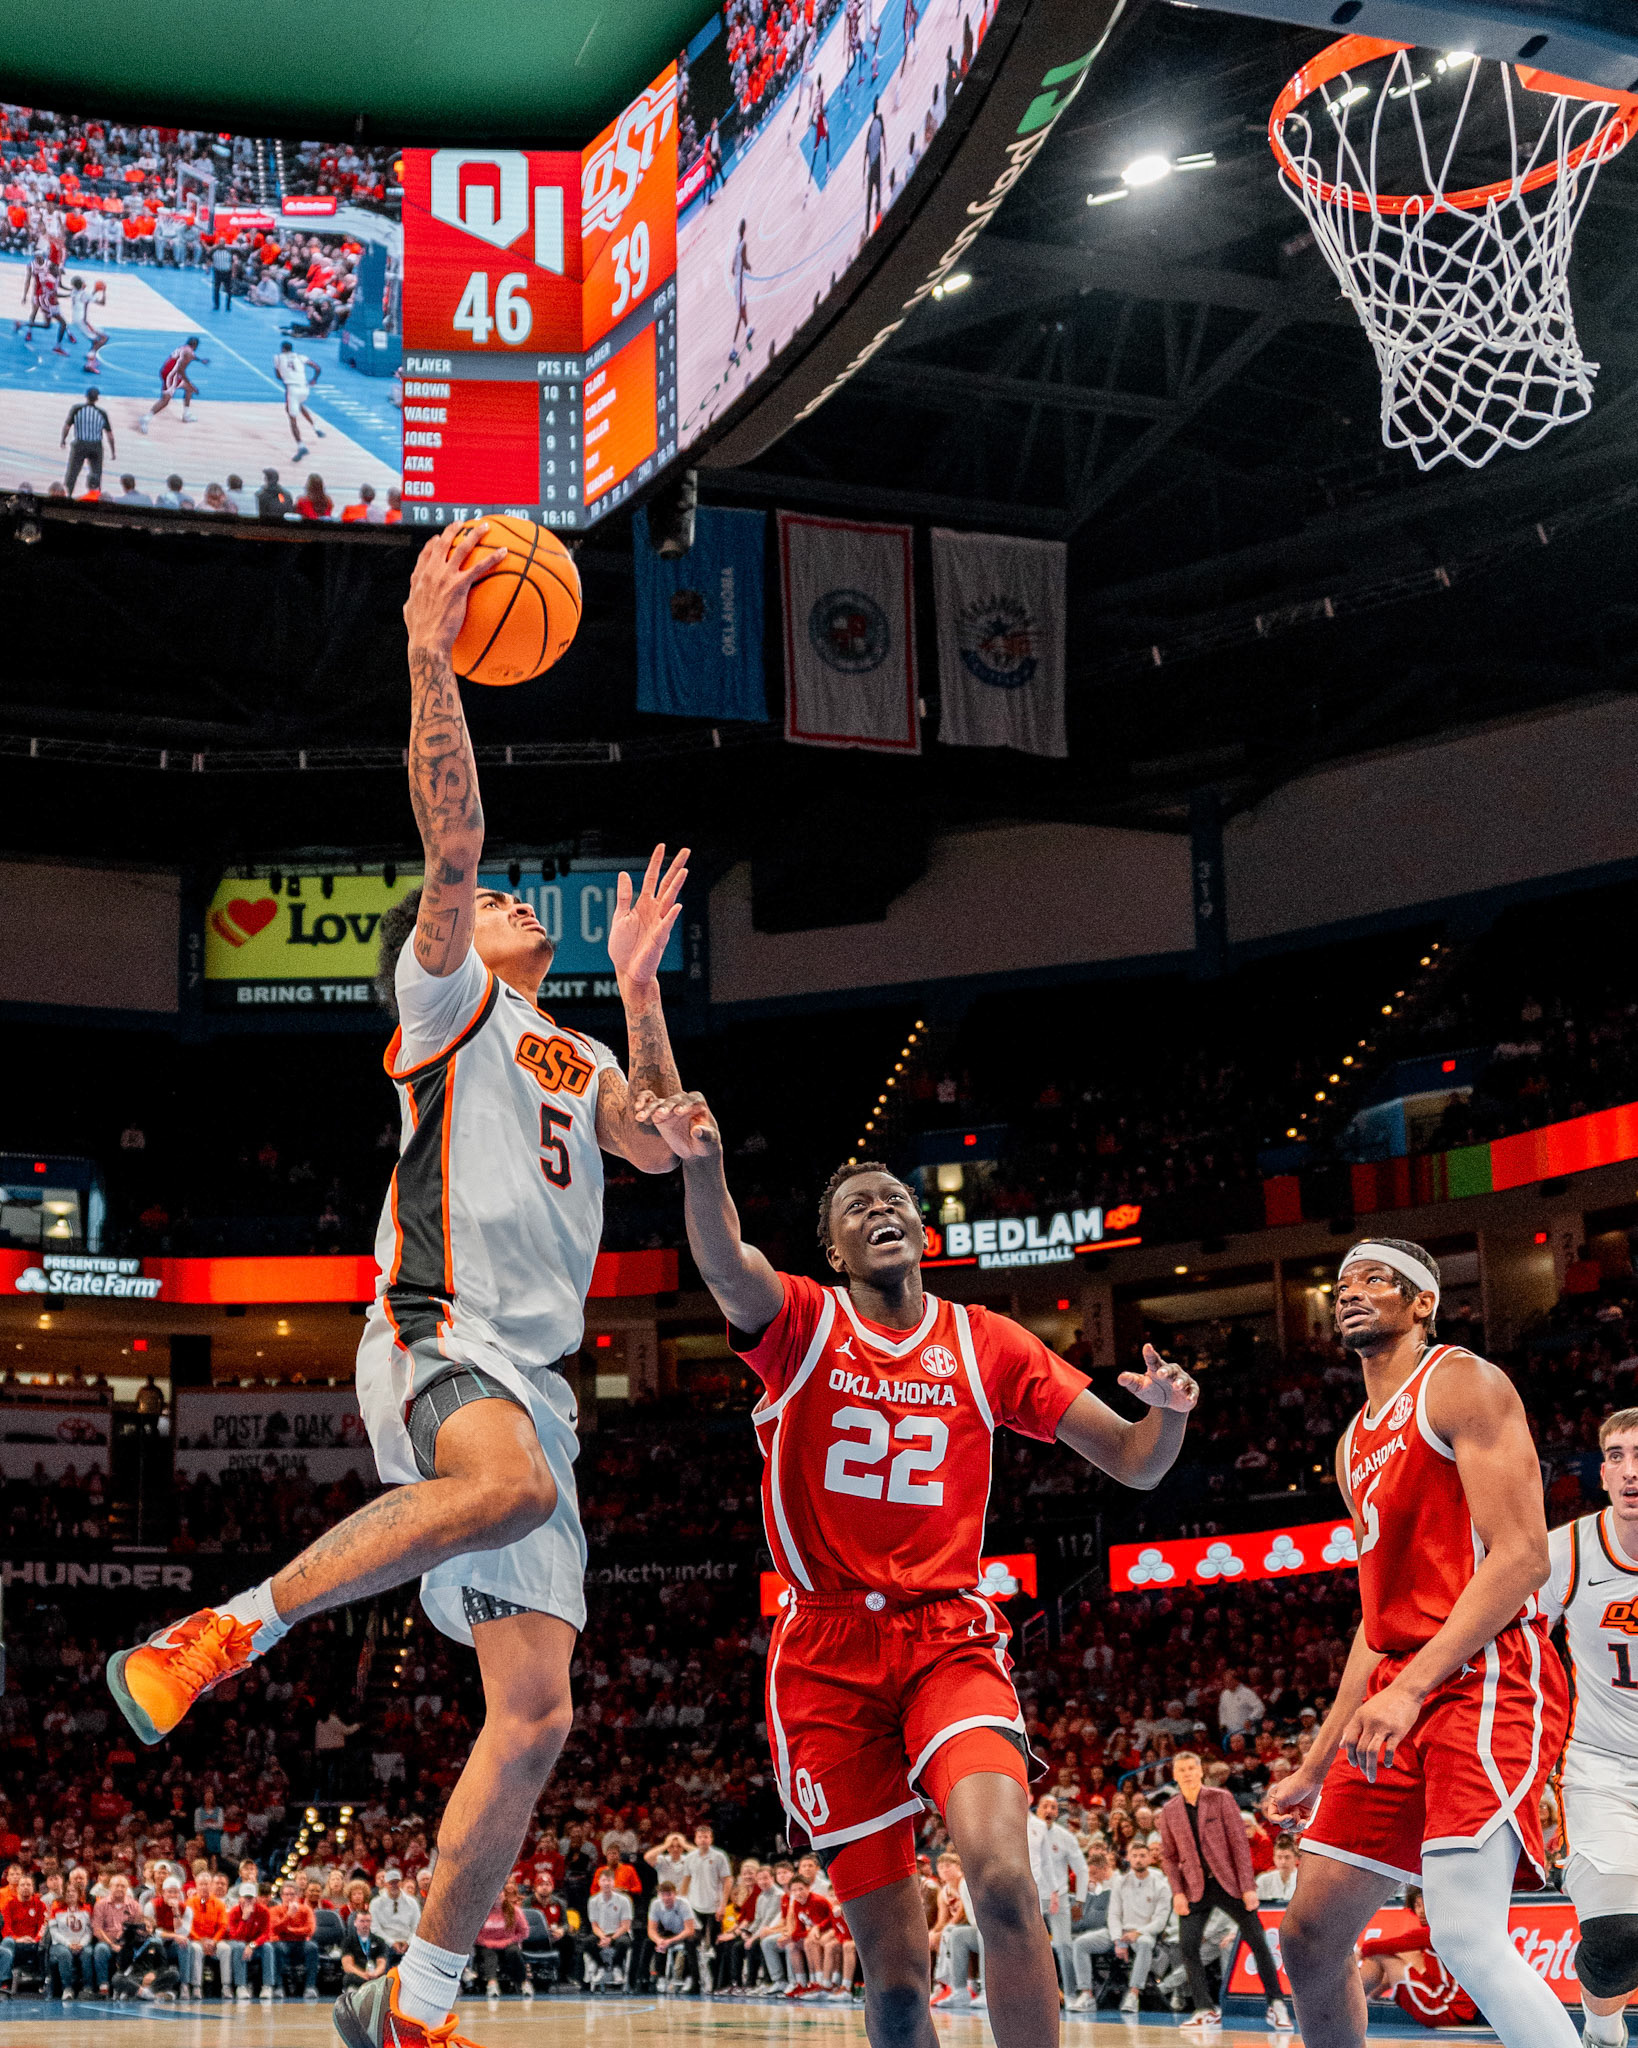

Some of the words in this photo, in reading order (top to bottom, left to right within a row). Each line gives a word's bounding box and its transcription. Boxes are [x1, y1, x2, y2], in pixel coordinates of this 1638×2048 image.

[611, 220, 651, 318] 39
[452, 271, 533, 346] 46
[406, 357, 452, 374] PLAYER
[537, 360, 562, 376] PTS
[564, 361, 580, 376] FL
[404, 381, 450, 399] BROWN
[543, 385, 559, 401] 10
[568, 385, 577, 401] 1
[404, 406, 447, 423] WAGUE
[545, 410, 556, 426] 4
[569, 410, 577, 425] 1
[404, 431, 442, 447] JONES
[546, 434, 556, 450] 9
[569, 434, 577, 450] 1
[404, 455, 435, 472] ATAK
[546, 459, 556, 475] 3
[569, 460, 577, 475] 1
[404, 480, 436, 497] REID
[547, 484, 556, 500] 5
[567, 484, 577, 500] 0
[413, 506, 430, 522] TO
[435, 507, 444, 522] 3
[452, 507, 469, 521] TF
[474, 508, 483, 520] 2
[542, 509, 577, 525] 16:16
[286, 902, 382, 946] Lov
[236, 985, 313, 1004] BRING
[320, 984, 369, 1001] THE
[514, 1031, 597, 1098] OSU
[539, 1101, 574, 1190] 5
[946, 1206, 1103, 1257] BEDLAM
[43, 1254, 118, 1272] PRESENTED
[118, 1258, 140, 1275] BY
[979, 1245, 1075, 1270] BASKETBALL
[922, 1347, 955, 1376] SEC
[828, 1368, 957, 1407] OKLAHOMA
[213, 1414, 262, 1439] POST
[294, 1414, 335, 1440] OAK
[824, 1405, 950, 1507] 22
[1351, 1433, 1407, 1490] OKLAHOMA
[1057, 1532, 1095, 1558] 112
[795, 1767, 830, 1827] OU
